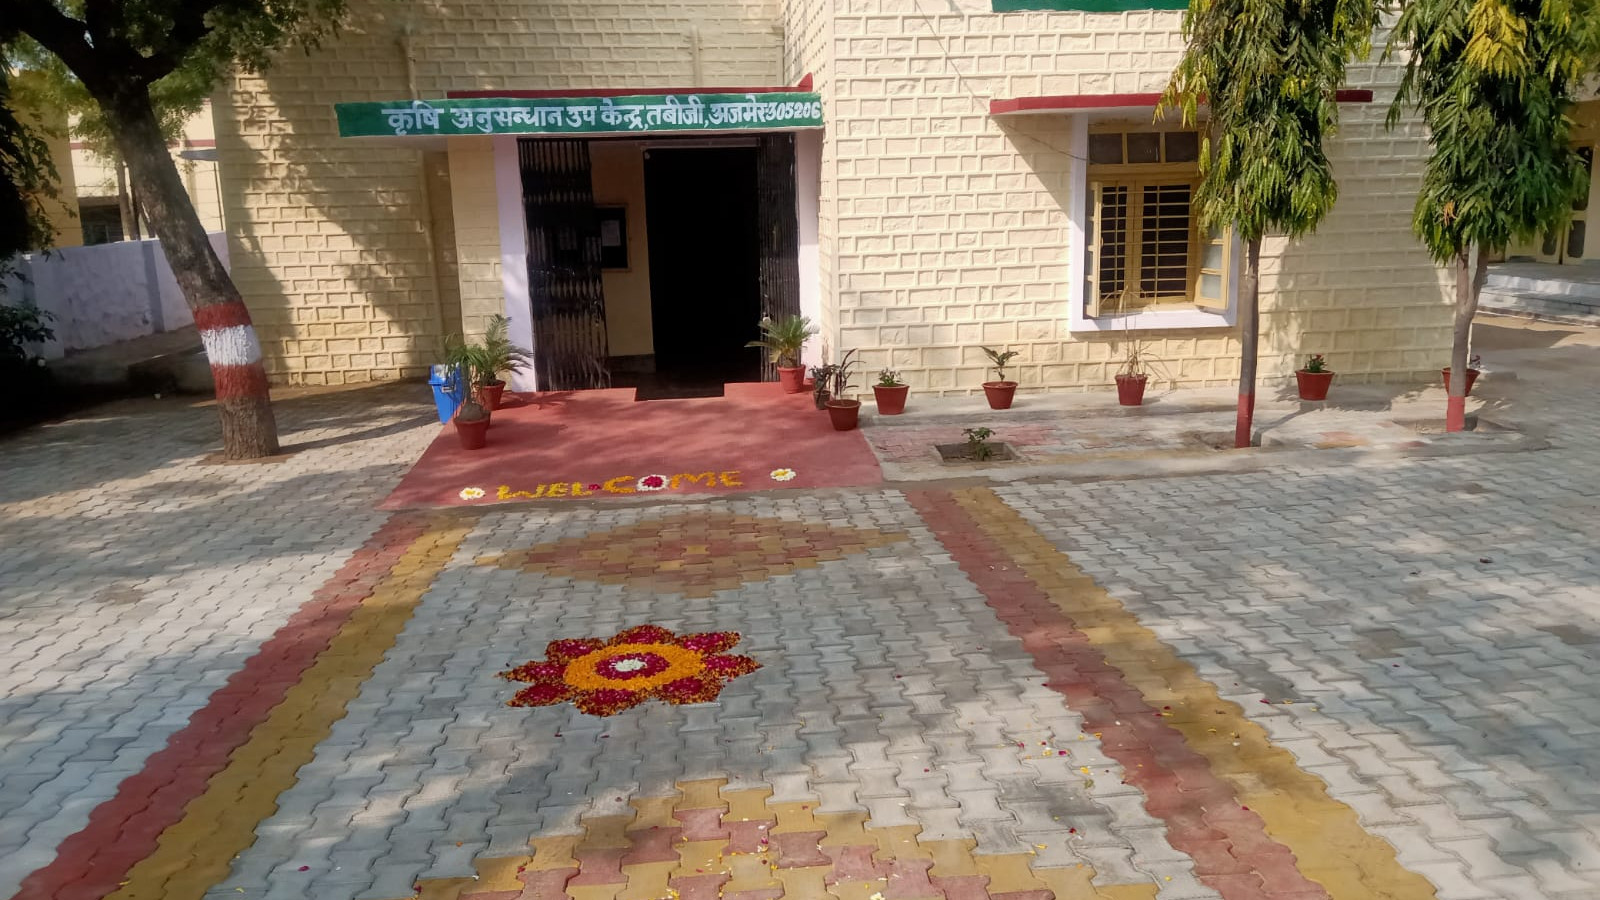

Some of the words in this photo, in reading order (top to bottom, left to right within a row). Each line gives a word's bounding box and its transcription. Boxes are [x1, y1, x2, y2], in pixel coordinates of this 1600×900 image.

[381, 100, 445, 135] कृषि
[450, 106, 564, 133] अनुसन्धान
[566, 105, 597, 127] उप
[497, 470, 744, 500] WELCOME
